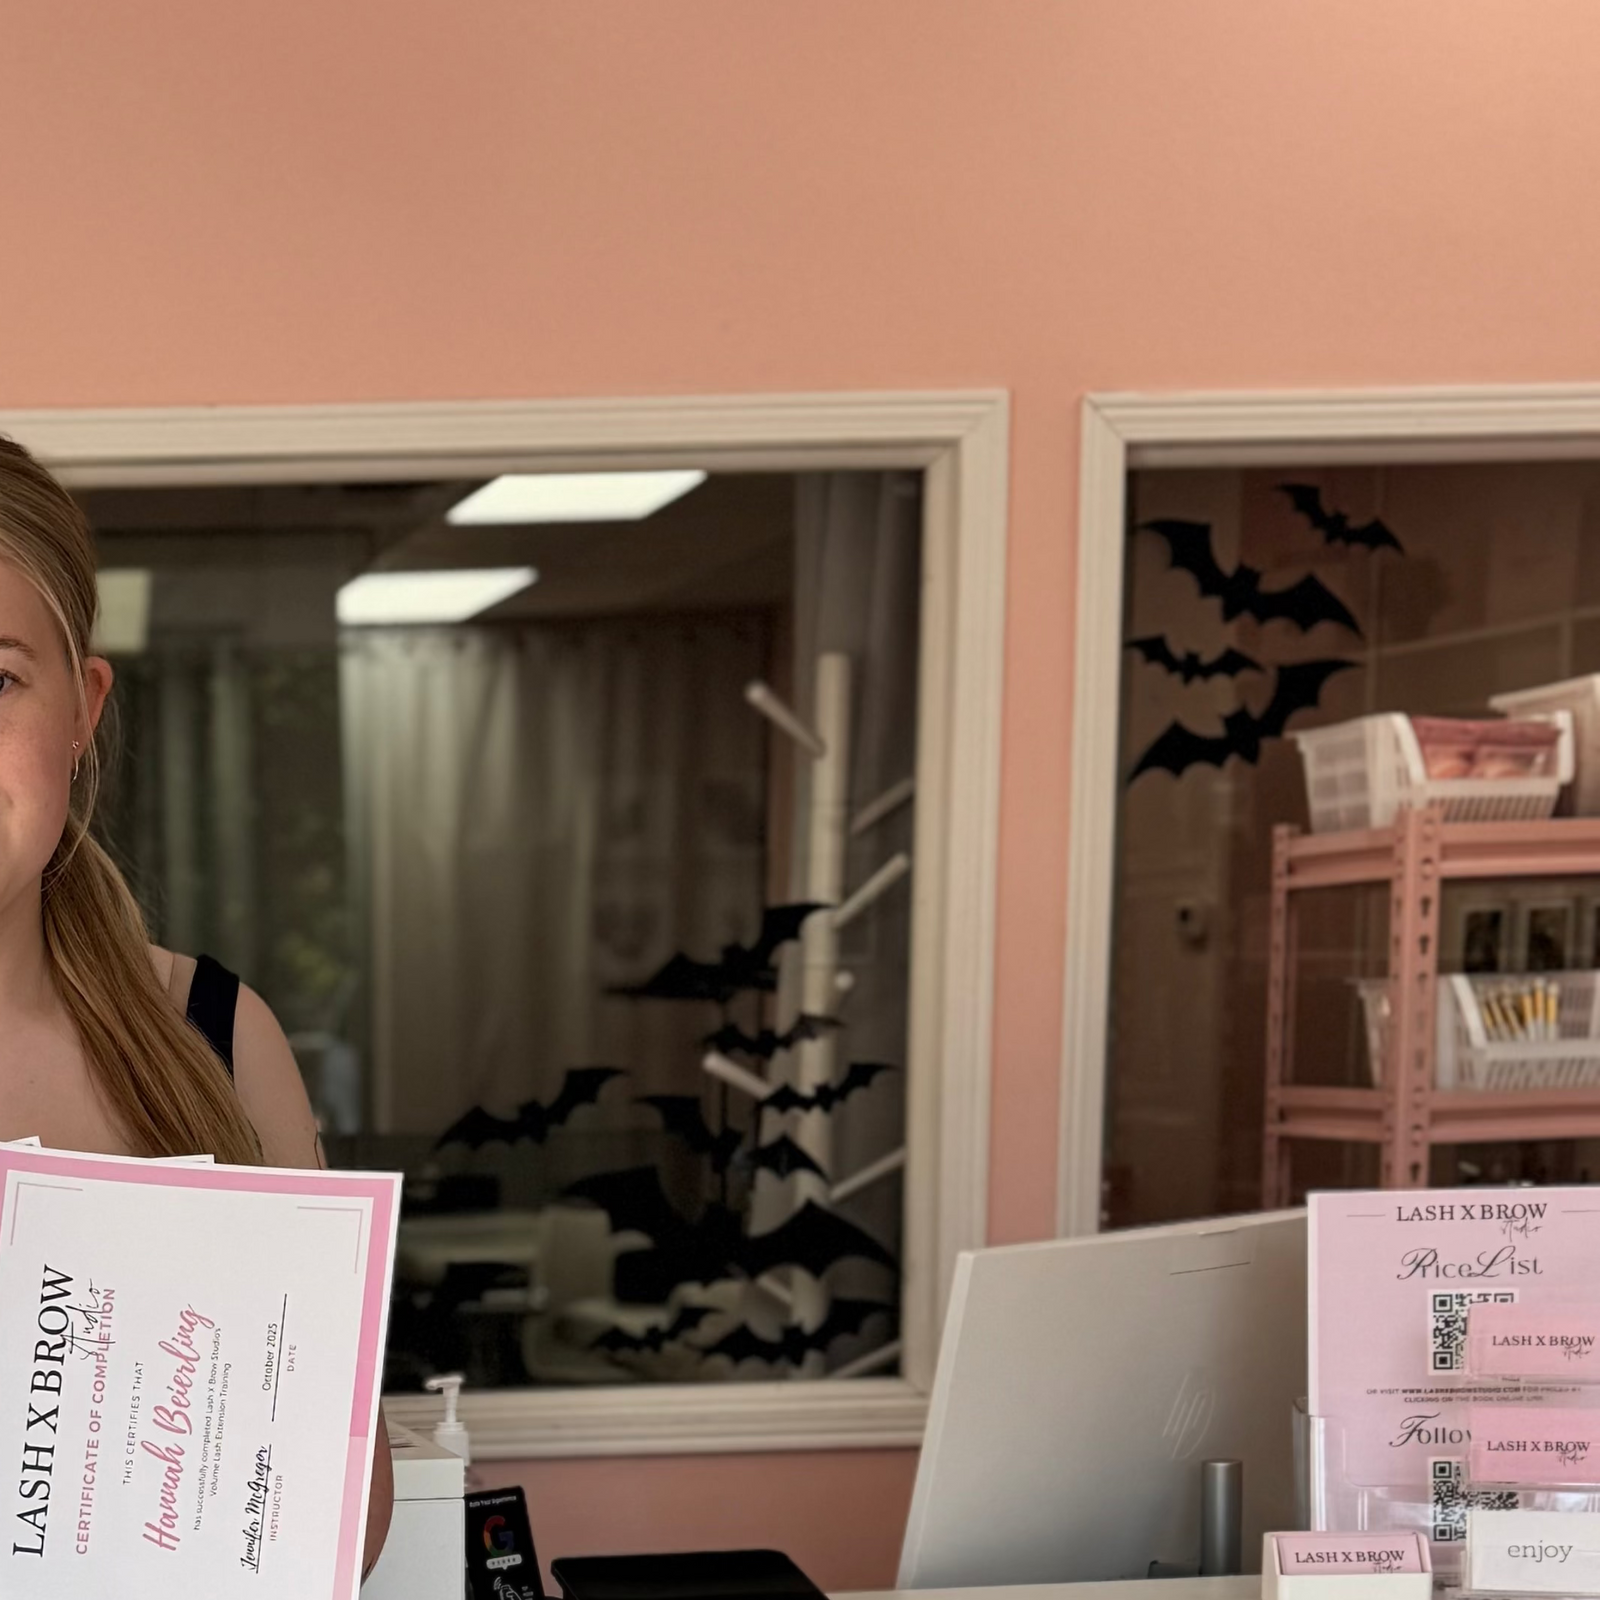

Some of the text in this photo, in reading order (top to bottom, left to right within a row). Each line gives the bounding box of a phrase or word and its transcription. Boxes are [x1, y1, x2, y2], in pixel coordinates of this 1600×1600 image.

[1396, 1203, 1548, 1222] LASH X BROW
[1467, 1245, 1544, 1278] List
[261, 1322, 278, 1391] October 2025
[286, 1344, 297, 1372] DATE
[1493, 1335, 1595, 1347] LASH X BROW
[208, 1362, 218, 1385] Brow
[12, 1264, 74, 1558] LASH X BROW
[76, 1288, 115, 1554] CERTIFICATE OF COMPLETION
[123, 1361, 144, 1485] THIS CERTIFIES THAT
[205, 1394, 214, 1413] Lash
[141, 1304, 215, 1551] Hannah Beierling
[200, 1416, 212, 1462] completed
[209, 1362, 231, 1496] Volume Lash Extension Training
[1487, 1441, 1591, 1452] LASH X BROW
[196, 1464, 208, 1514] successfully
[239, 1446, 272, 1570] Jennifer McGregor
[269, 1475, 283, 1542] INSTRUCTOR
[193, 1515, 202, 1531] has
[1295, 1550, 1405, 1563] LASH X BROW
[1507, 1540, 1573, 1563] enjoy
